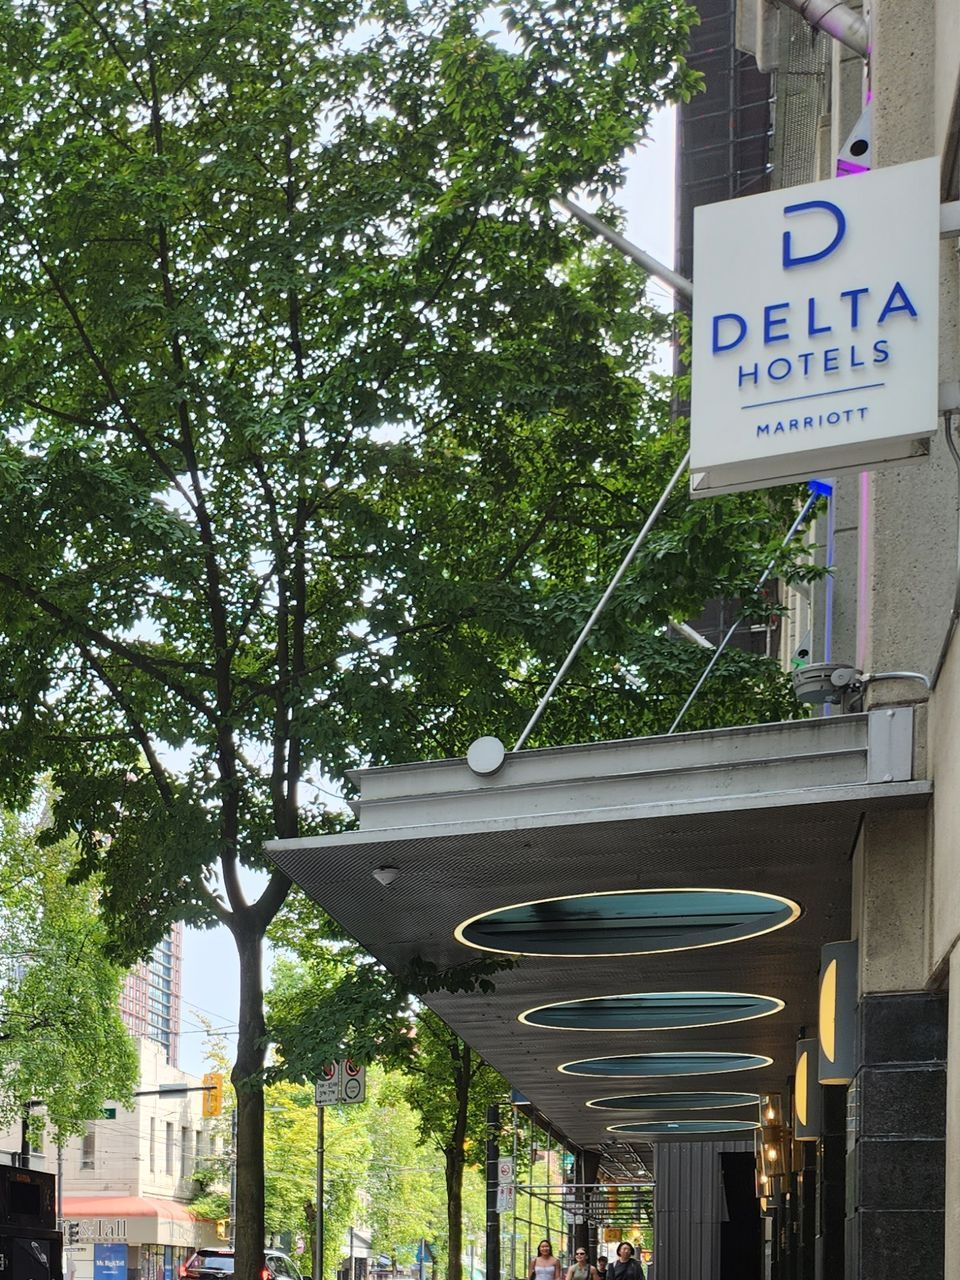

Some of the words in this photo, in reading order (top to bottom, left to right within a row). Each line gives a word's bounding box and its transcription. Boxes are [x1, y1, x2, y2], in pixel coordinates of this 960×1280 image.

[712, 281, 918, 357] DELTA
[738, 339, 890, 387] HOTELS
[756, 406, 870, 438] MARRIOTT
[94, 1219, 127, 1238] Tall
